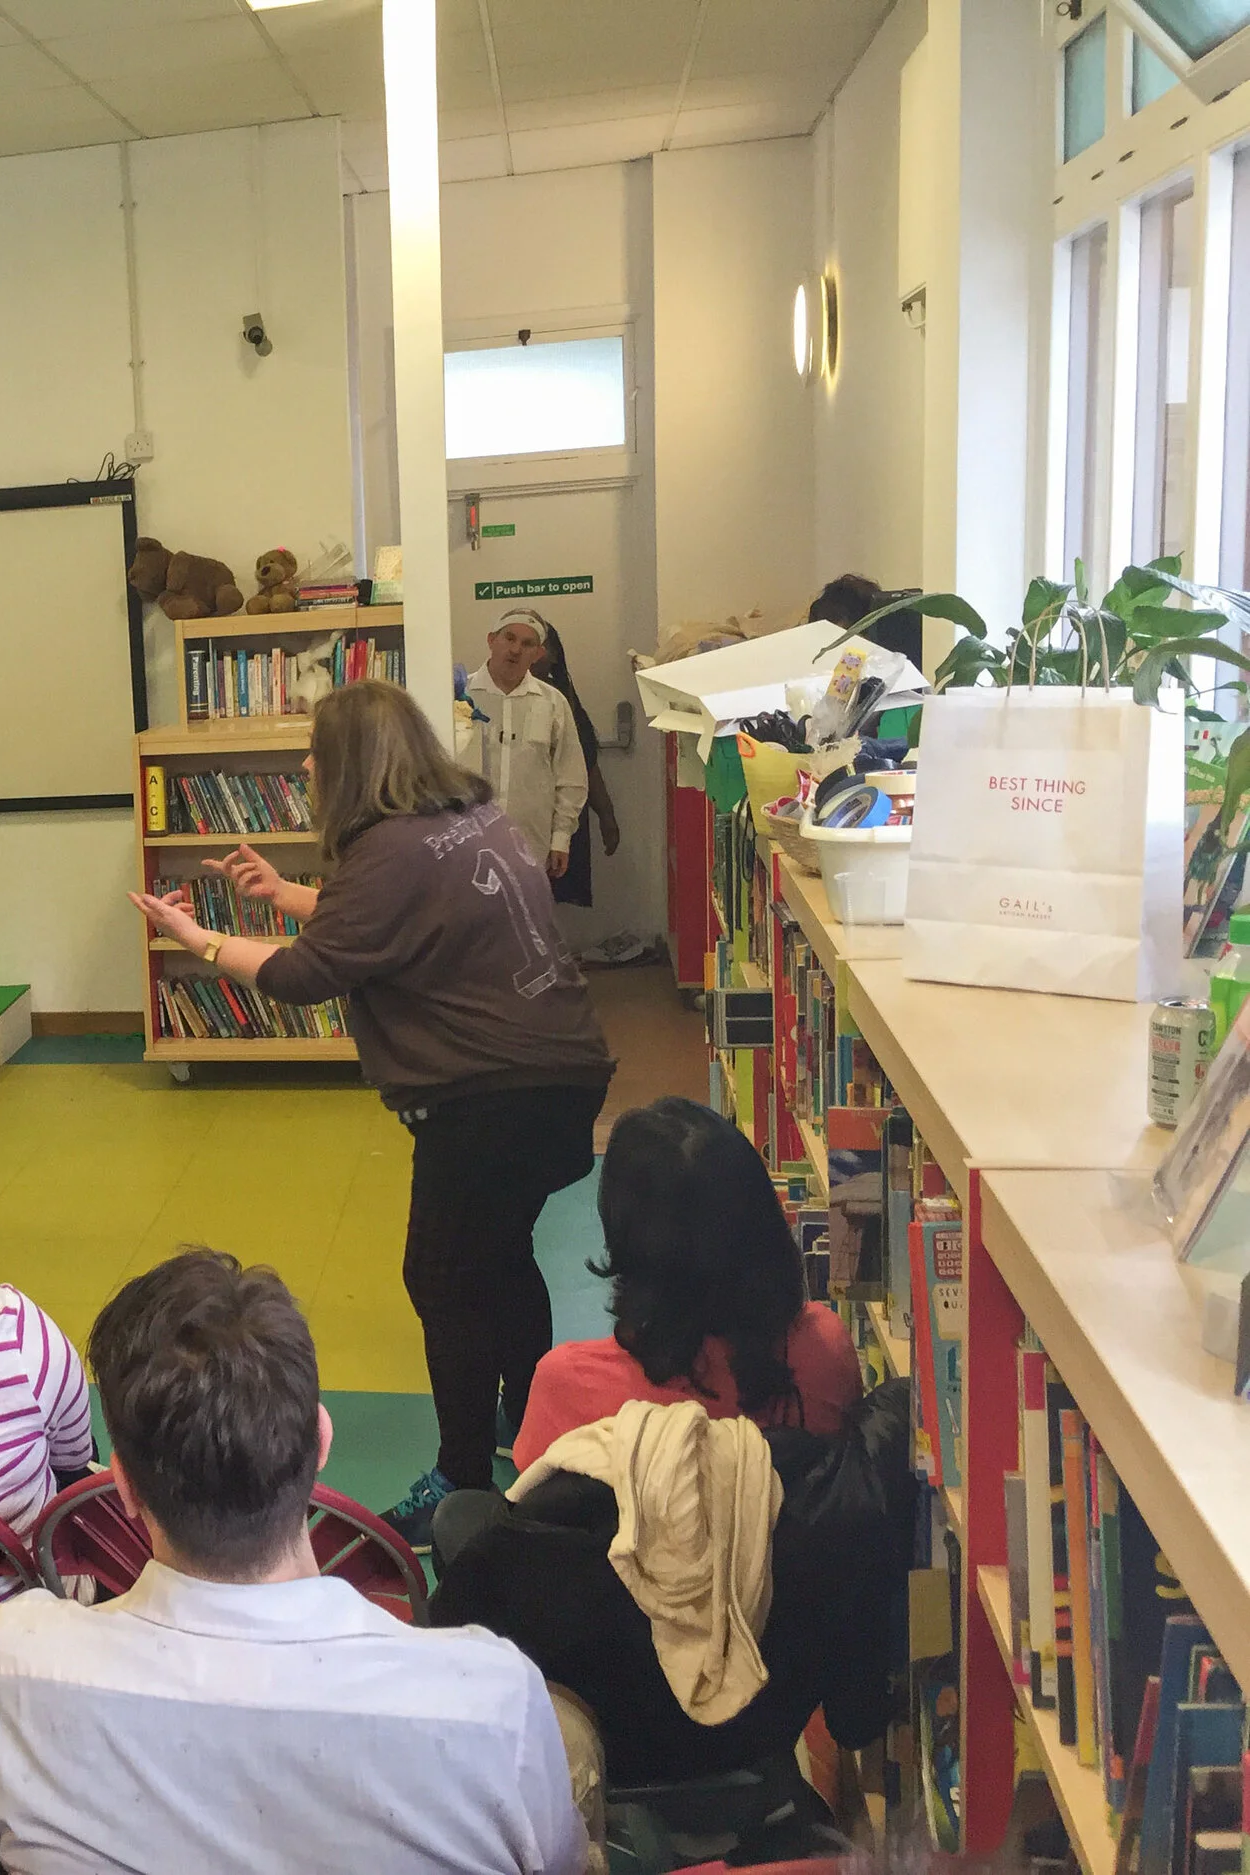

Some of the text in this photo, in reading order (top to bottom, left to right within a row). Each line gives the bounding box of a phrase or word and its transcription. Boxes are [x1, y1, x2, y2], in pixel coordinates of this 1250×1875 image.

[496, 581, 591, 596] Push bar to open
[191, 655, 200, 696] Parenting
[149, 775, 158, 785] A
[989, 776, 1086, 795] BEST THING
[150, 806, 158, 816] C
[1010, 796, 1064, 813] SINCE
